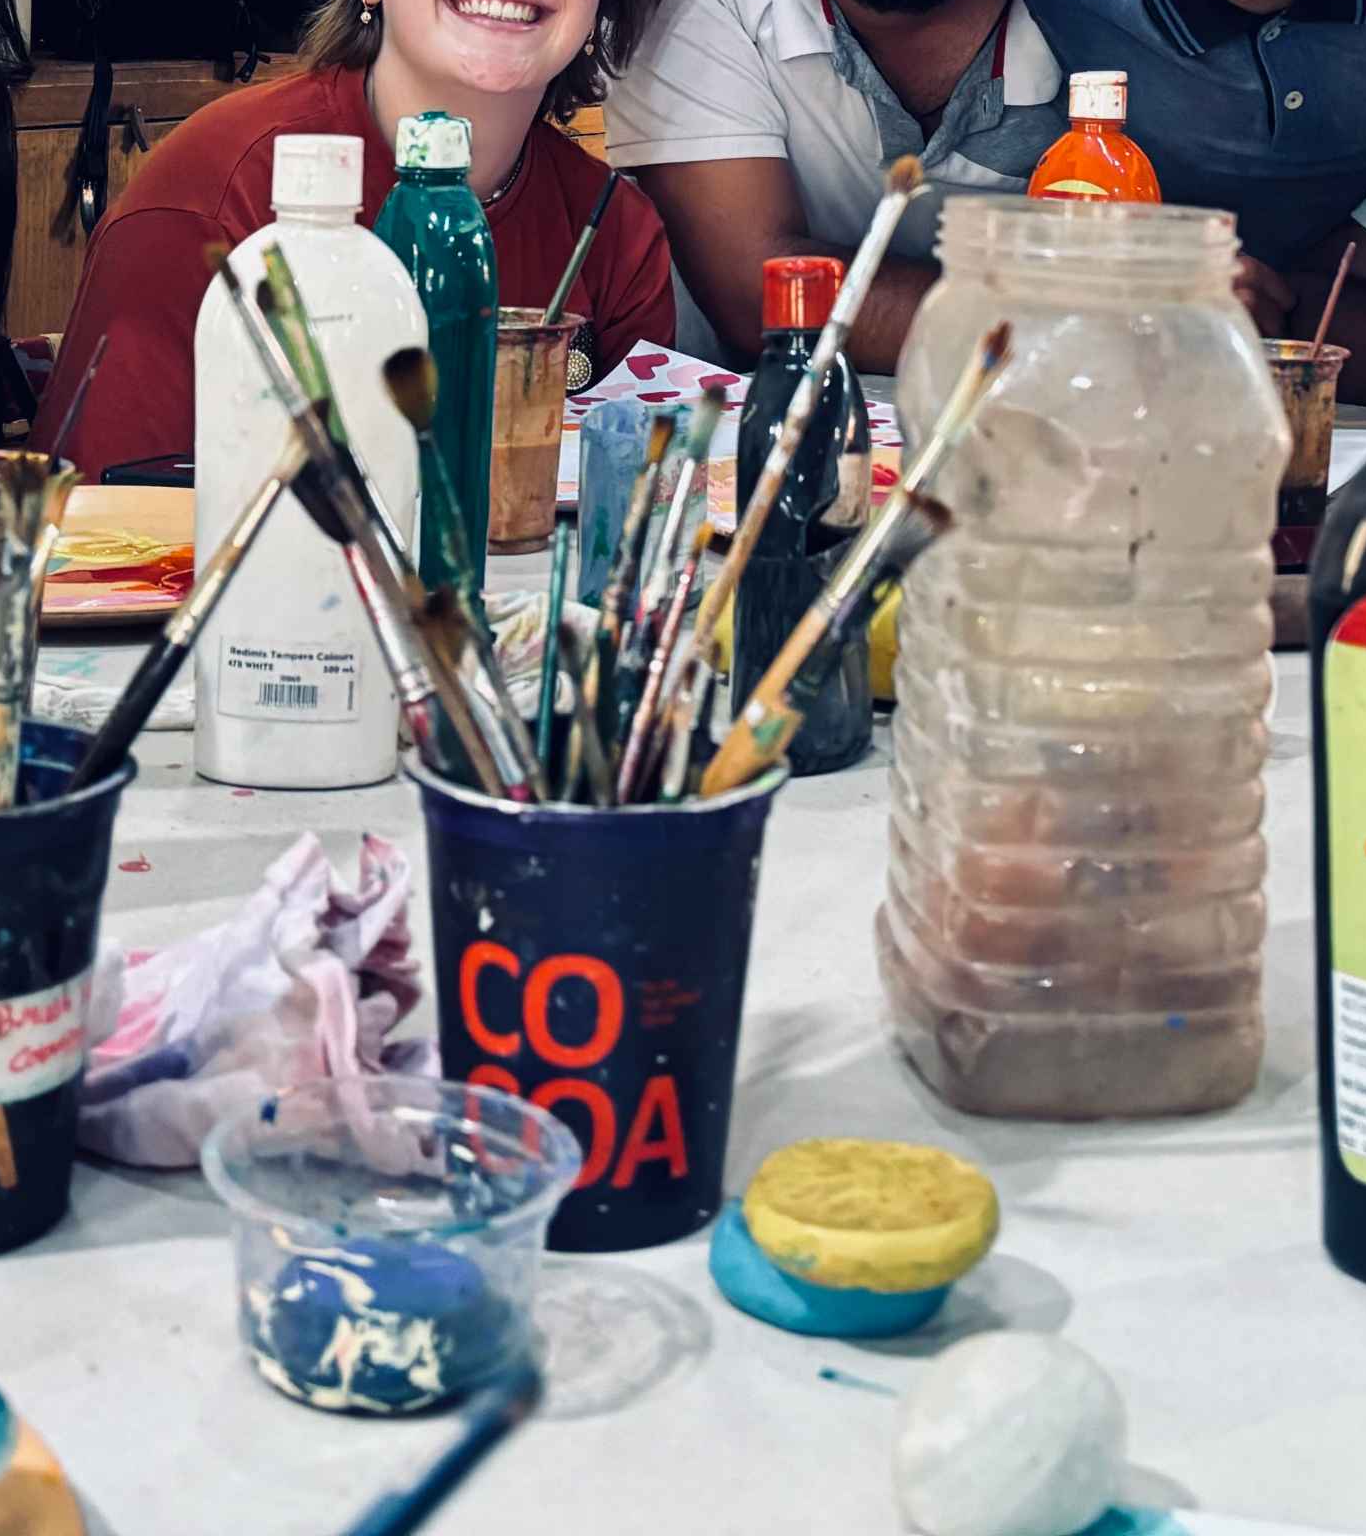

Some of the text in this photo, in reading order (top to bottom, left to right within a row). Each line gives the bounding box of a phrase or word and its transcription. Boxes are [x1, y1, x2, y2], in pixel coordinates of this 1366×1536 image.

[245, 661, 274, 672] WHITE
[459, 939, 625, 1069] CO
[464, 1064, 690, 1190] COA
